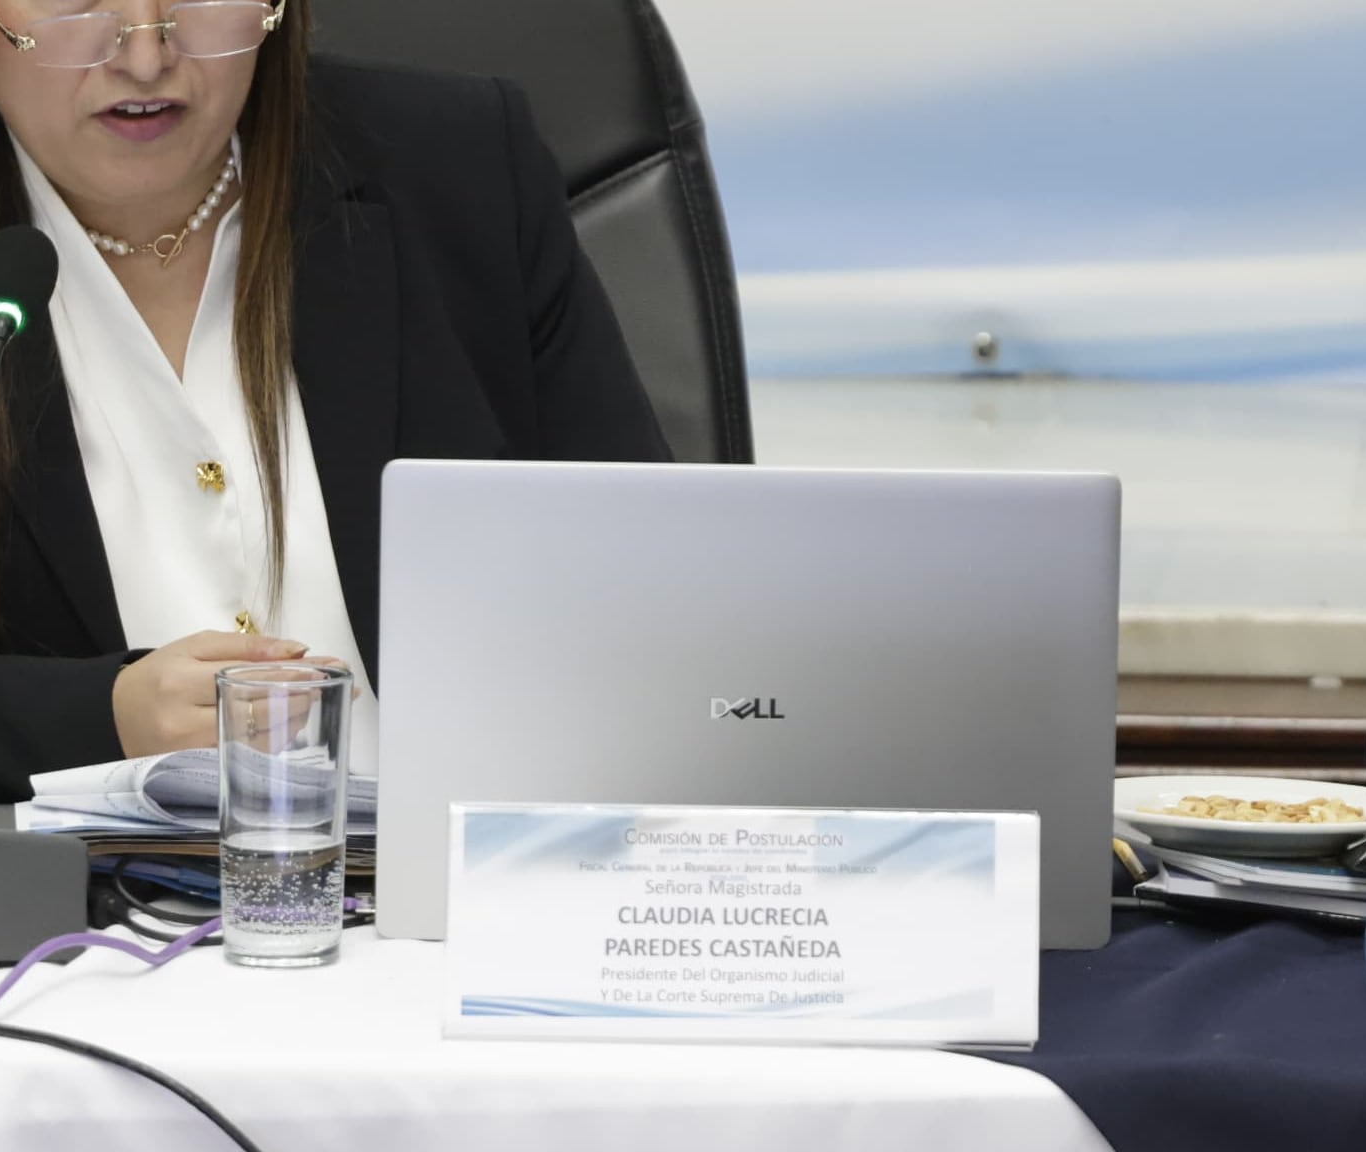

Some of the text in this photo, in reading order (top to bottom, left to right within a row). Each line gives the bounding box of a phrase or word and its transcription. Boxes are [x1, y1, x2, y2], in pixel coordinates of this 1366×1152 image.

[710, 697, 785, 720] DELL
[708, 832, 728, 846] DE
[644, 879, 803, 898] Señora Magistrada
[618, 906, 829, 927] CLAUDIA LUCRECIA
[604, 934, 842, 958] PAREDES CASTAÑEDA
[601, 967, 845, 984] Presidente Del Organismo Judicial
[601, 988, 609, 1001] Y
[613, 988, 633, 1002] De
[637, 989, 652, 1002] La
[656, 989, 697, 1003] Corte
[700, 989, 764, 1006] Suprema
[770, 990, 787, 1003] De
